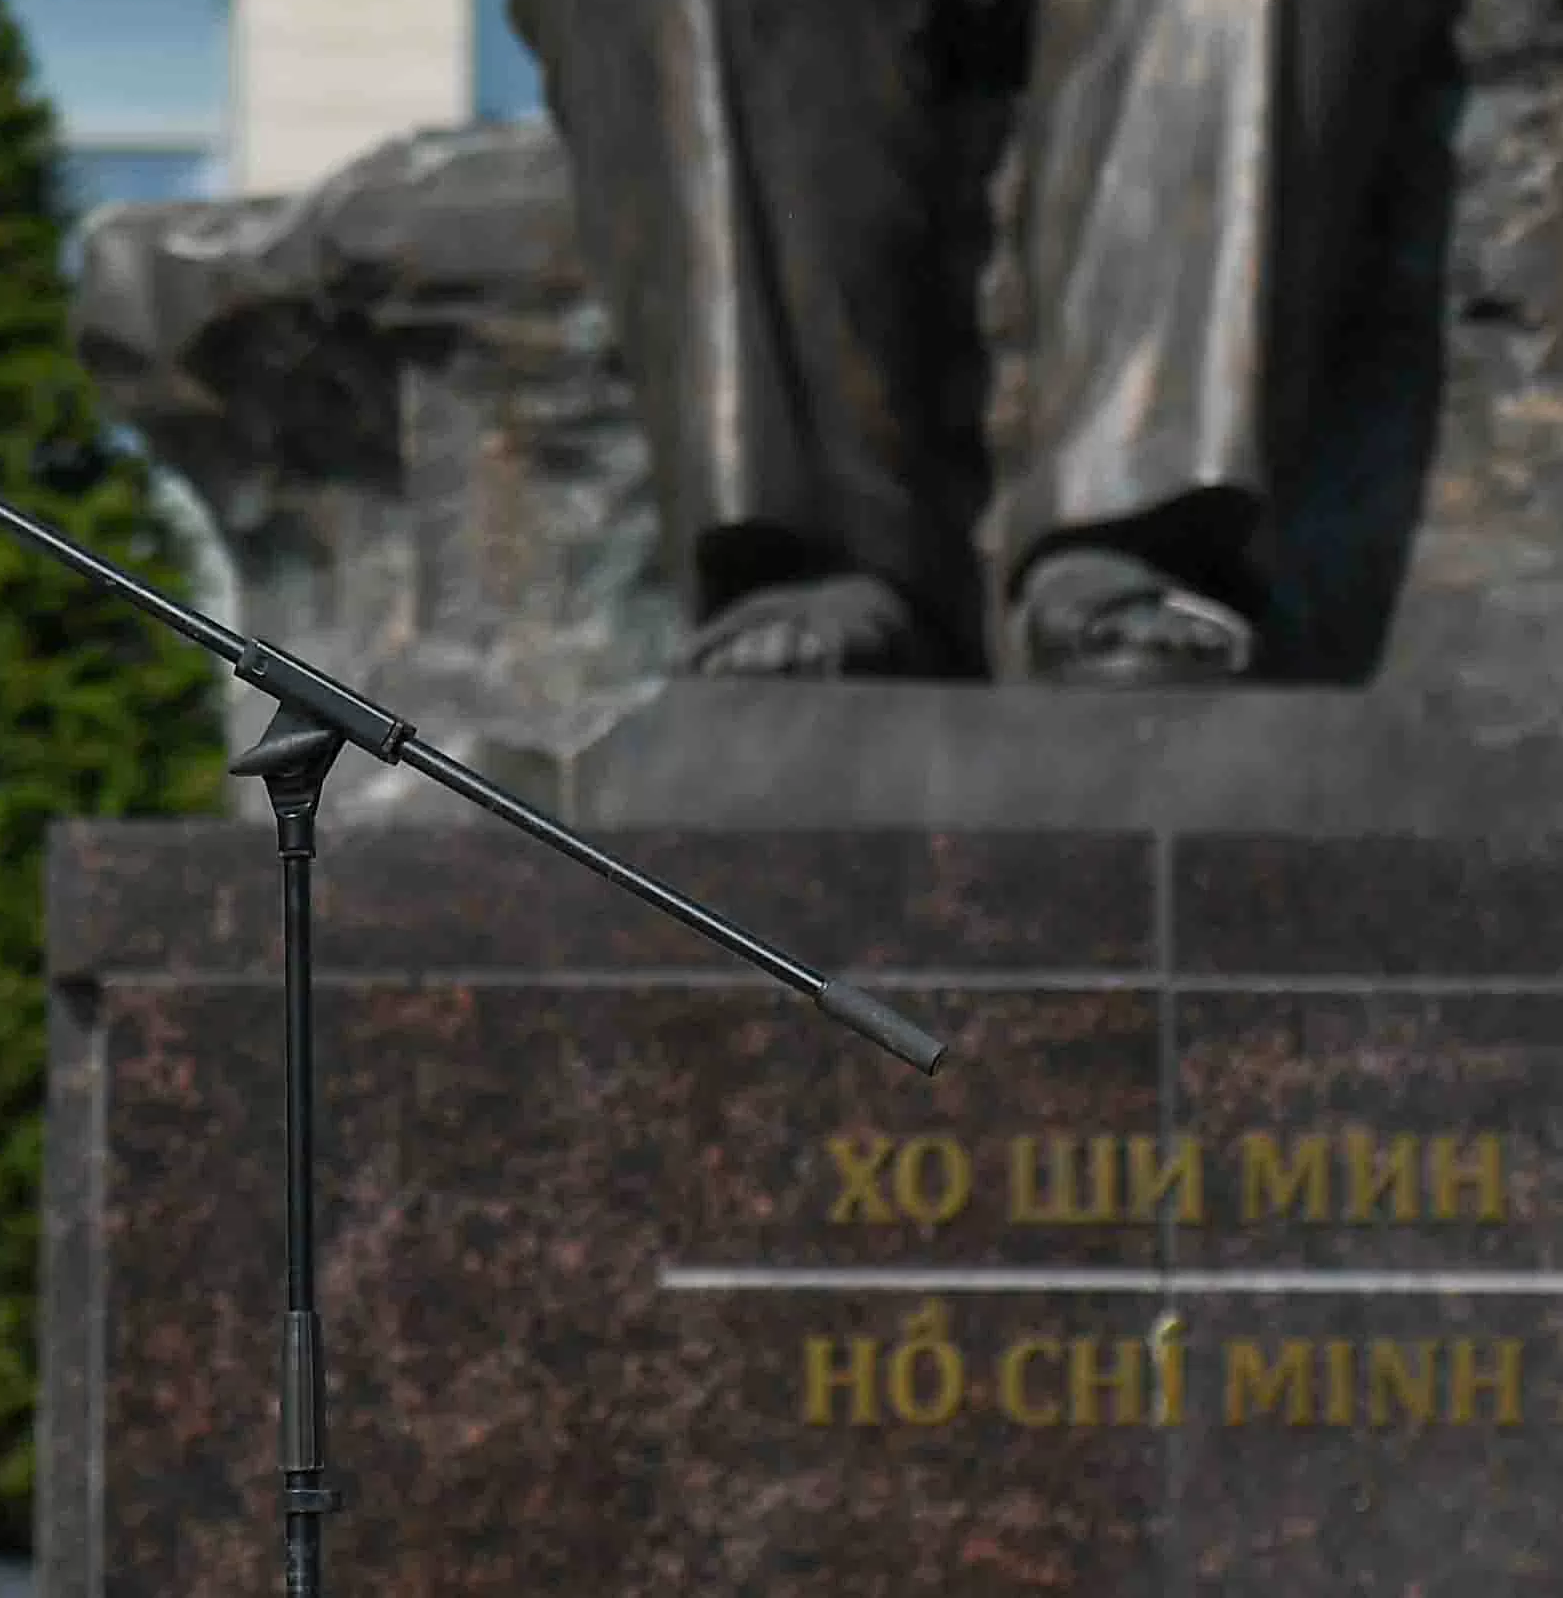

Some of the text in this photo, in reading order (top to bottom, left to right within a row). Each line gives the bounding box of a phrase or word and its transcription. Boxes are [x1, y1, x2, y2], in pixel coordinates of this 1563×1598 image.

[826, 1132, 1509, 1226] ХО ШИ МИН
[998, 1310, 1187, 1428] CHÍ
[1223, 1336, 1524, 1428] MINH
